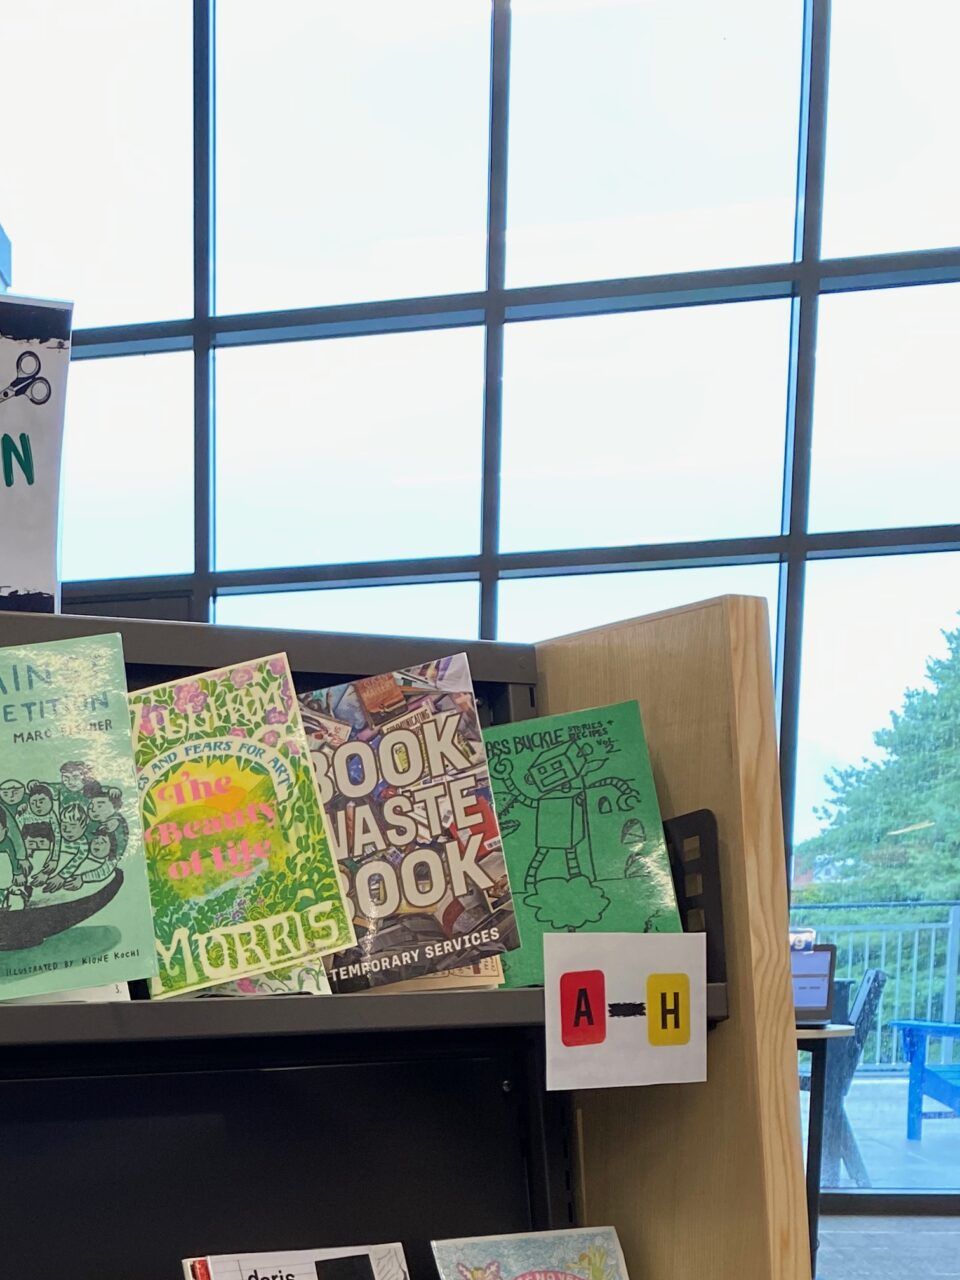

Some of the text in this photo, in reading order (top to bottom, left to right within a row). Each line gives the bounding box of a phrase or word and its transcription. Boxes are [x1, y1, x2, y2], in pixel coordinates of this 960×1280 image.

[513, 727, 564, 755] BUCKLE
[151, 740, 293, 787] AND FEARS FOR ART
[157, 771, 233, 805] The
[144, 803, 276, 846] Beauty
[167, 837, 273, 880] of Life
[156, 901, 342, 984] MORRIS
[330, 949, 421, 982] TEMPORARY
[424, 927, 501, 959] SERVICES
[6, 962, 58, 976] ILLUSTRATED
[64, 960, 74, 968] BY
